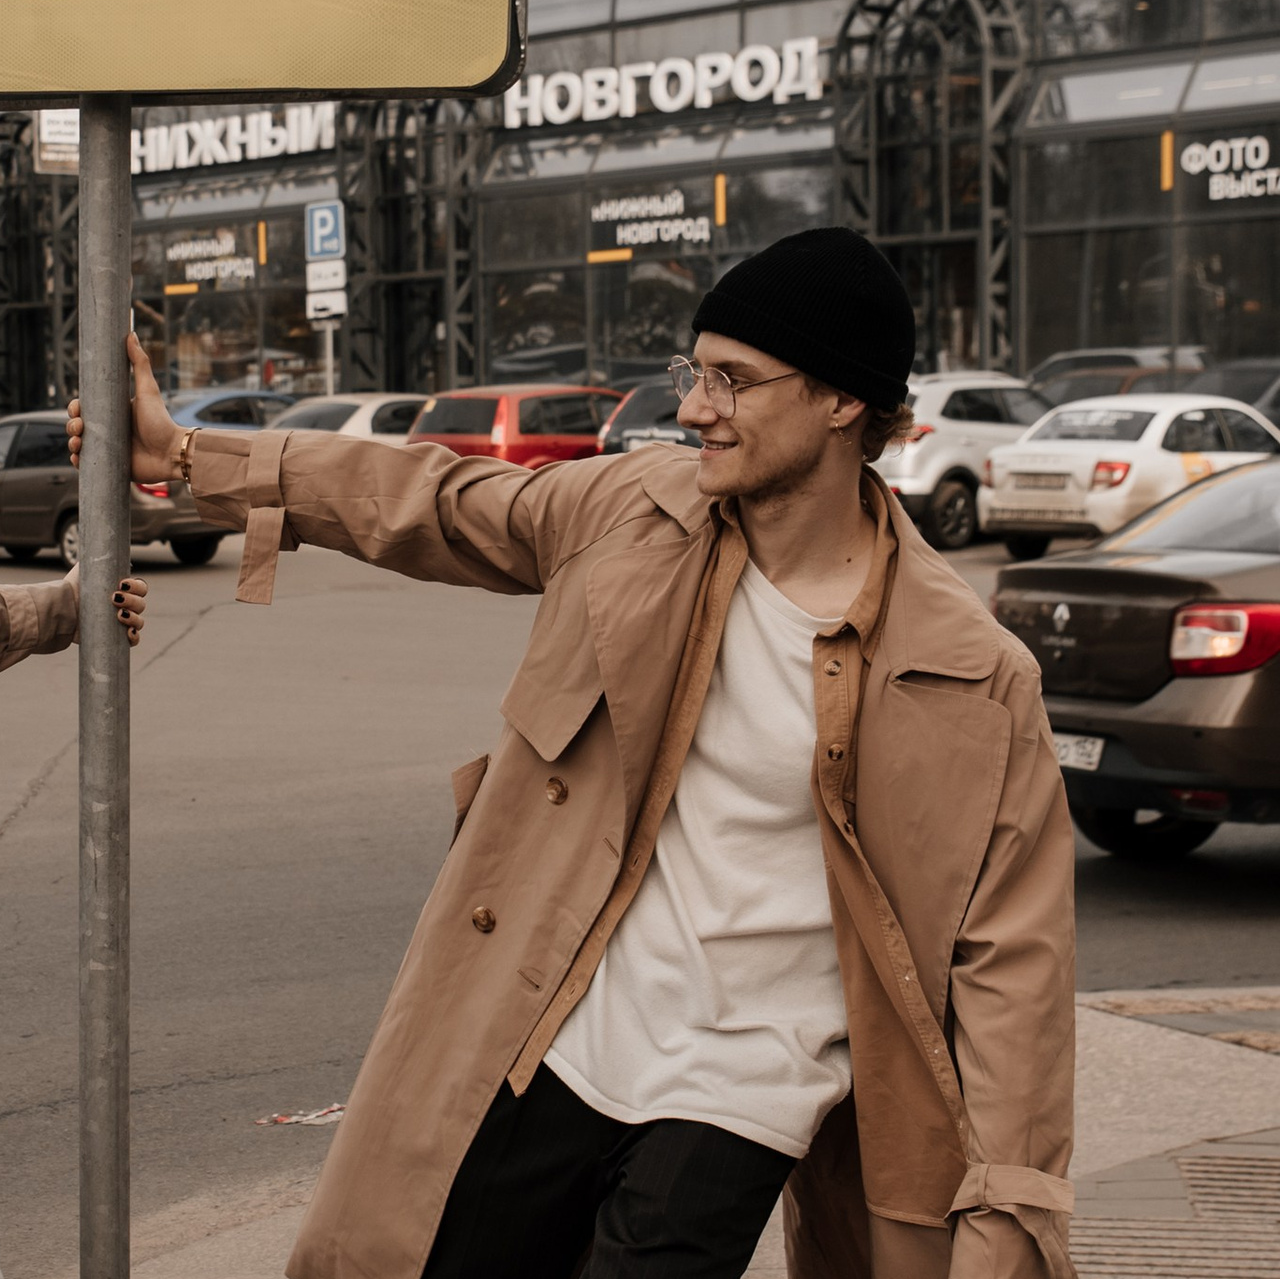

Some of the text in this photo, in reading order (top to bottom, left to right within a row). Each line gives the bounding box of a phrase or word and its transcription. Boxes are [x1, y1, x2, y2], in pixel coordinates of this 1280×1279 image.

[131, 36, 823, 174] НИЖНЫЙ НОВГОРОД
[1180, 135, 1270, 175] ФОТО
[616, 216, 711, 246] НОВГОРОД
